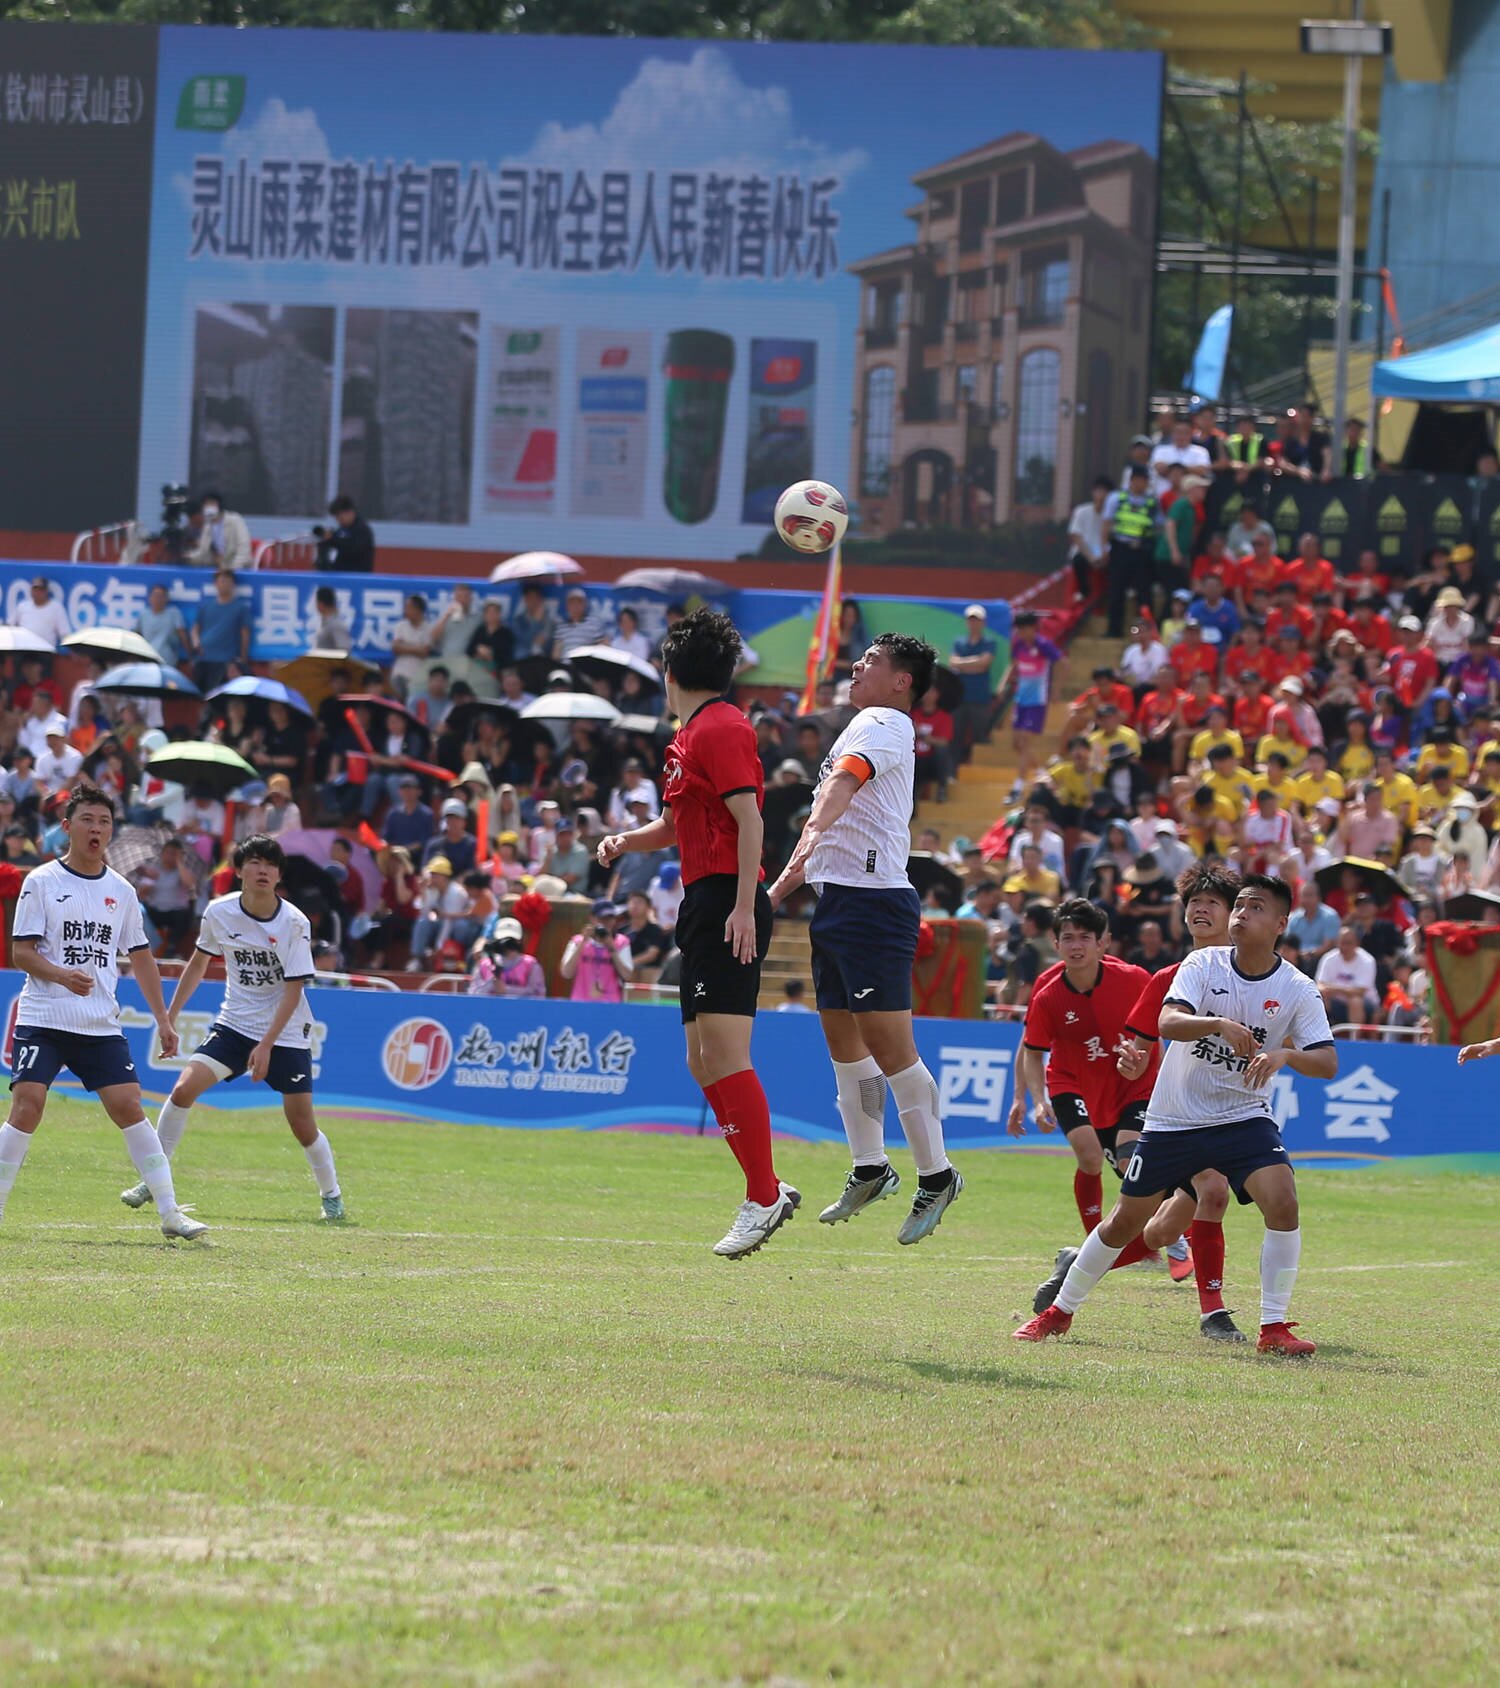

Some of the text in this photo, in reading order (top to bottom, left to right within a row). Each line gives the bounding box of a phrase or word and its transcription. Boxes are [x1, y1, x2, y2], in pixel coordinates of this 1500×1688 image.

[0, 72, 144, 125] 钦州市灵山县)
[0, 178, 80, 240] 兴市队
[191, 157, 840, 279] 灵山雨柔建材有限公司祝全县人民新春快乐
[63, 920, 113, 945] 防城港
[63, 945, 109, 969] 东兴市
[17, 1045, 40, 1071] 27
[456, 1022, 635, 1074] 柳州银行
[455, 1067, 629, 1094] BANK OF LIUZHOU
